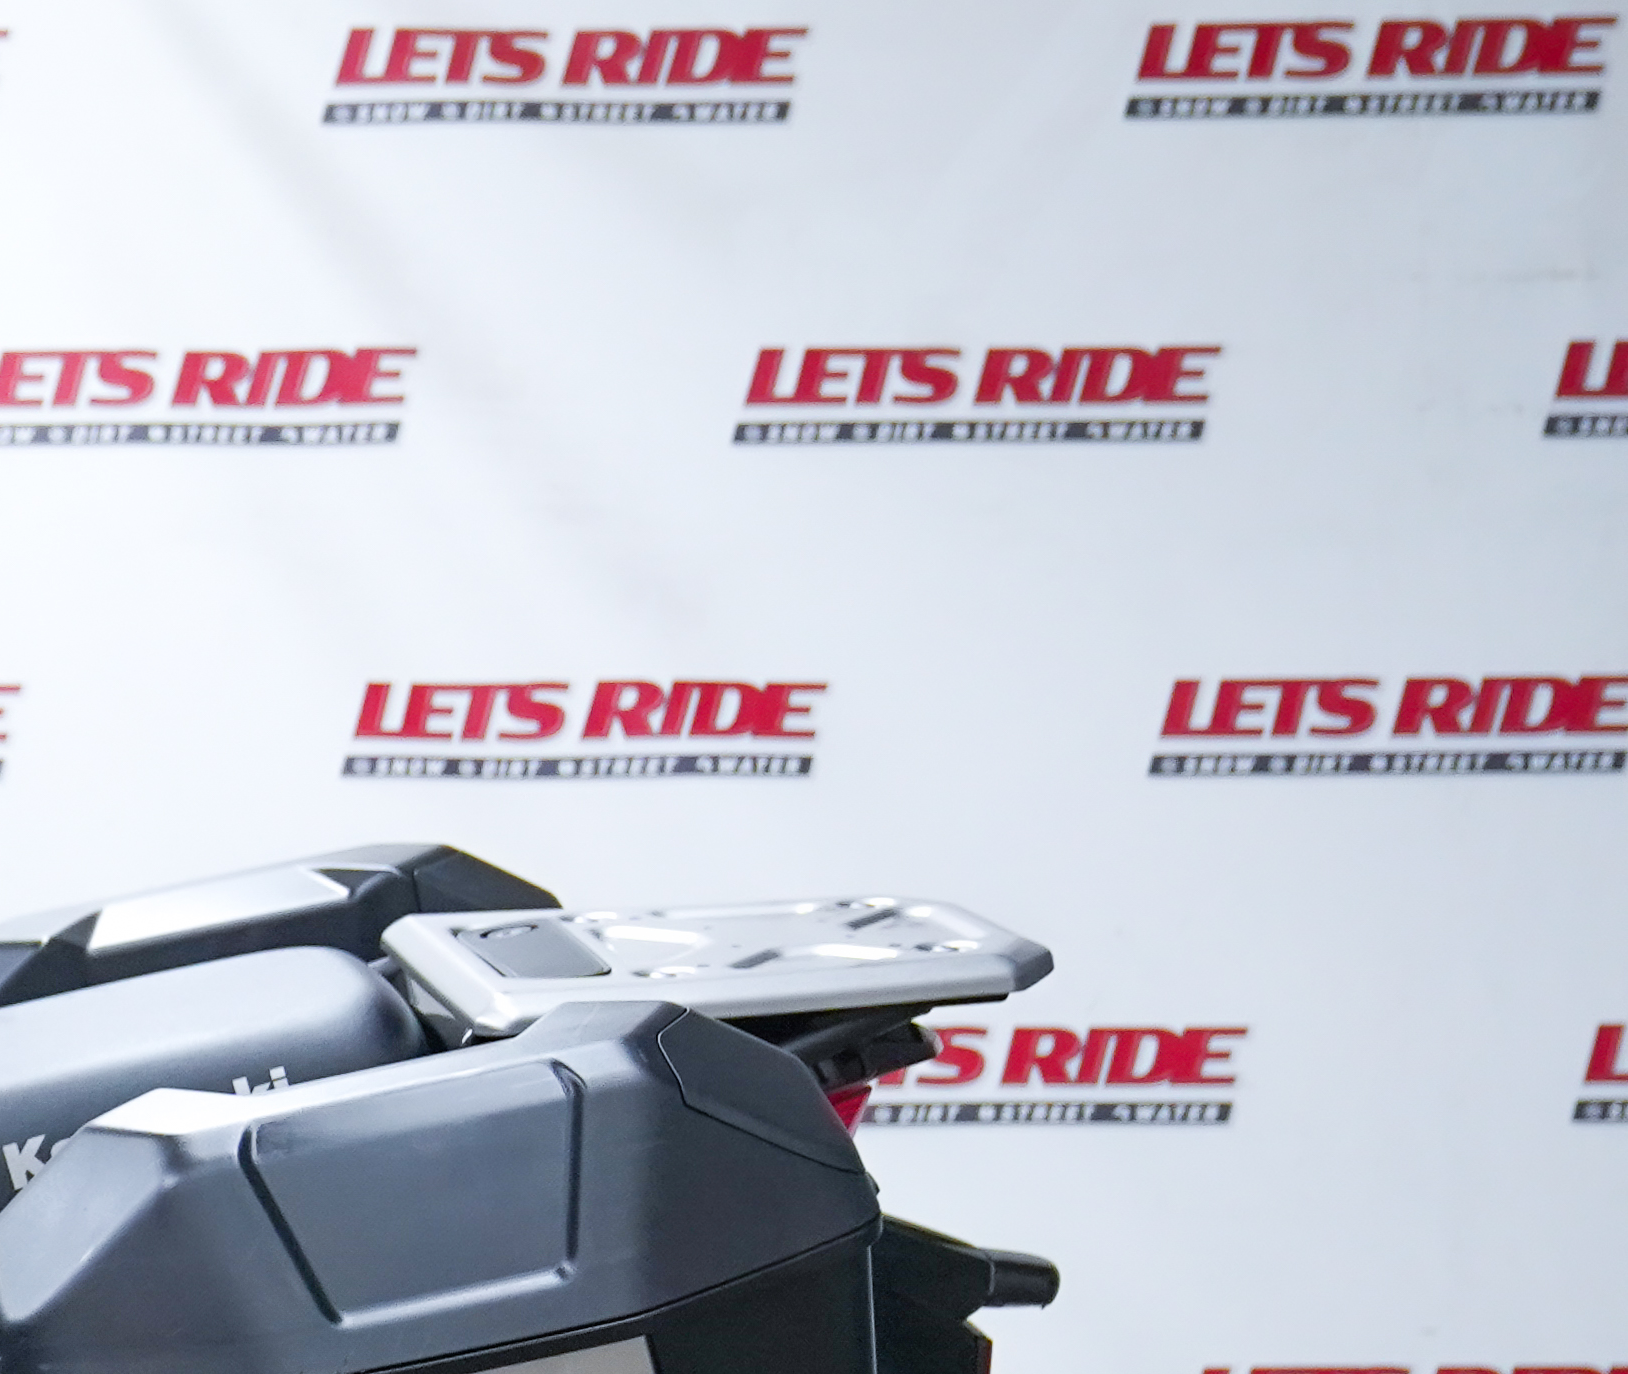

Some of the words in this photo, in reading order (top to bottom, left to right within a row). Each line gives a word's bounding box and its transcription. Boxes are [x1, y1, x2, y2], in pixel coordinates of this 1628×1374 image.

[337, 29, 547, 84] LETS
[563, 29, 807, 85] RIDE
[1138, 22, 1350, 79] LETS
[1368, 18, 1614, 77] RIDE
[172, 348, 415, 406] RIDE
[746, 348, 959, 404] LETS
[975, 347, 1219, 403] RIDE
[355, 682, 567, 740] LETS
[583, 681, 827, 738] RIDE
[1161, 679, 1378, 736] LETS
[1393, 676, 1628, 734] RIDE
[1002, 1028, 1248, 1084] RIDE
